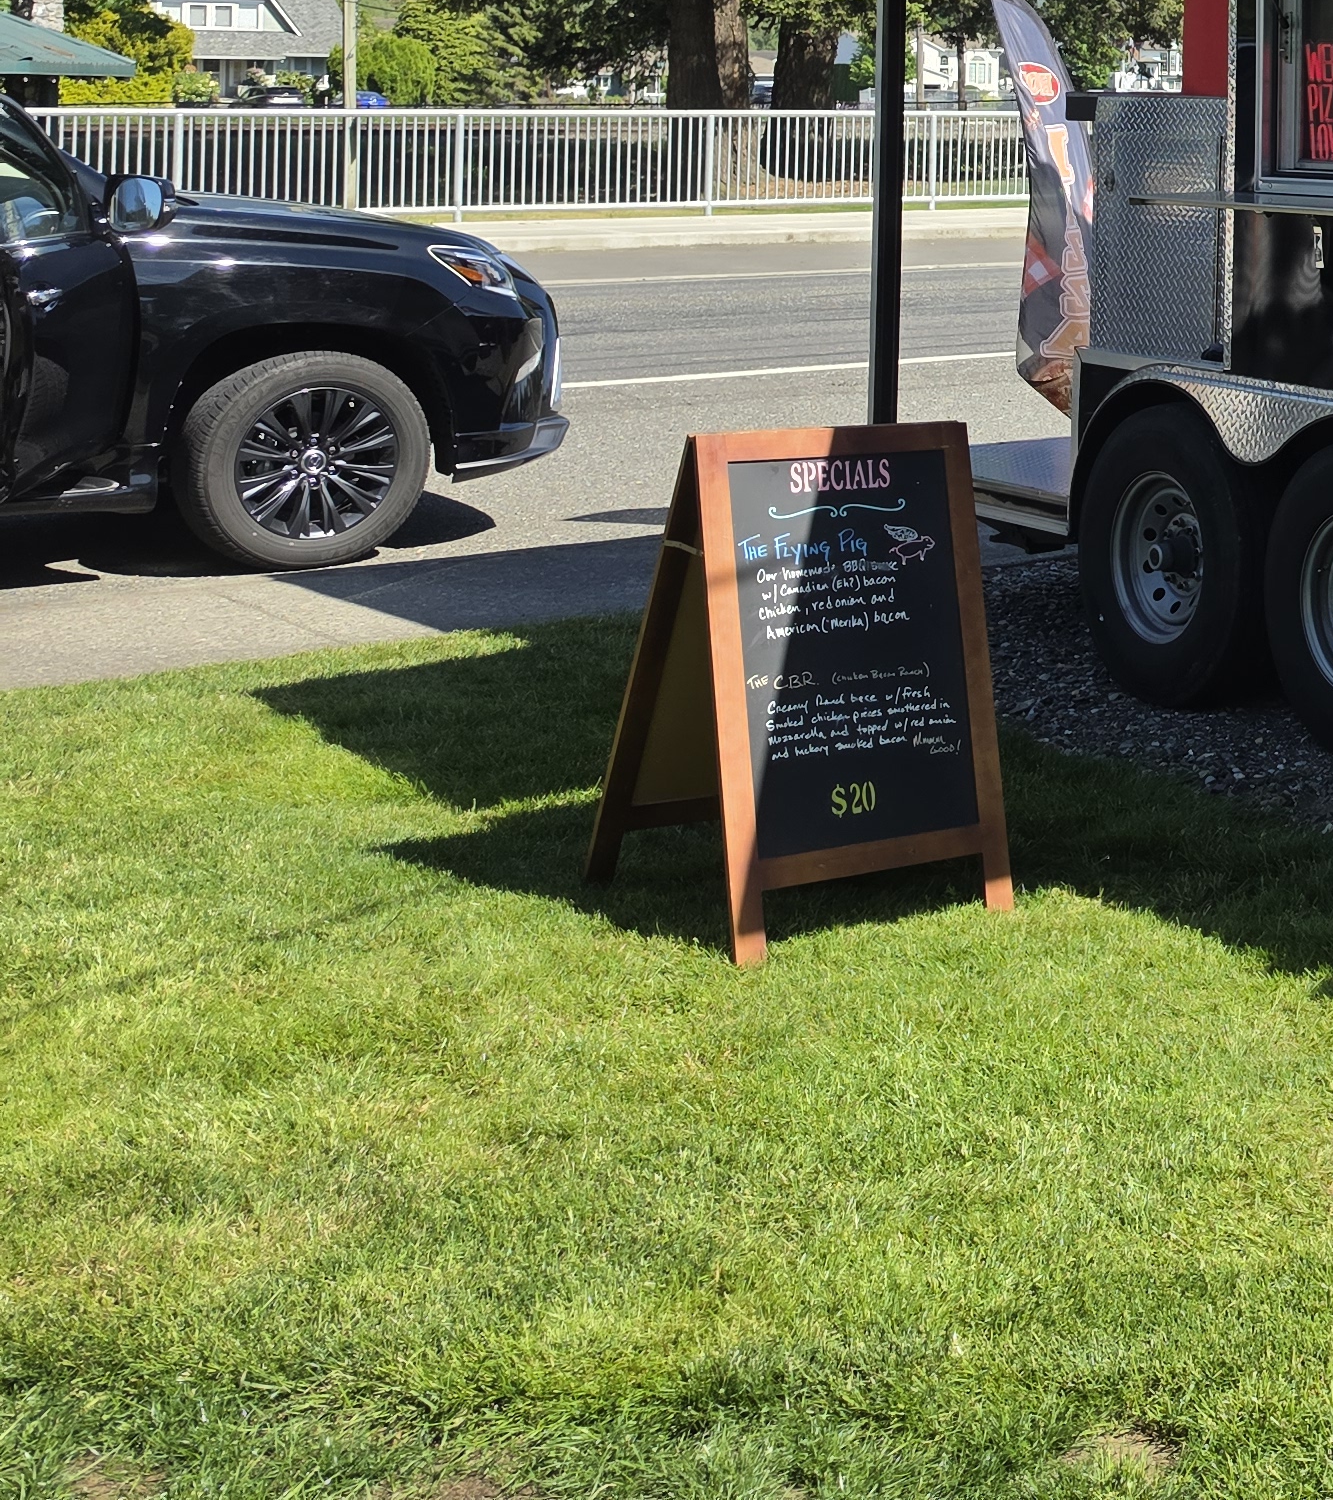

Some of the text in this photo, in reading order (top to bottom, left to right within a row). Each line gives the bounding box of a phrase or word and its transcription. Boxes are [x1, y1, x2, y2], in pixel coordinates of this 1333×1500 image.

[790, 458, 891, 493] SPECIALS
[738, 528, 867, 565] THE FLYING PIG
[757, 568, 777, 583] Our
[842, 558, 866, 572] BBQ
[863, 576, 896, 586] bacon
[812, 595, 833, 610] red
[835, 596, 866, 608] onion
[871, 588, 895, 604] and
[766, 622, 821, 639] American
[874, 611, 911, 624] bacon
[747, 674, 768, 689] THE
[767, 700, 808, 715] Creamy
[811, 711, 850, 724] chicken
[853, 707, 882, 723] pieces
[939, 698, 950, 709] in
[830, 724, 849, 738] and
[856, 719, 888, 735] topped
[928, 714, 956, 725] onion
[771, 746, 789, 760] and
[795, 743, 829, 756] hickory
[835, 737, 874, 750] smoked
[879, 735, 908, 745] bacon
[831, 781, 876, 818] $20
